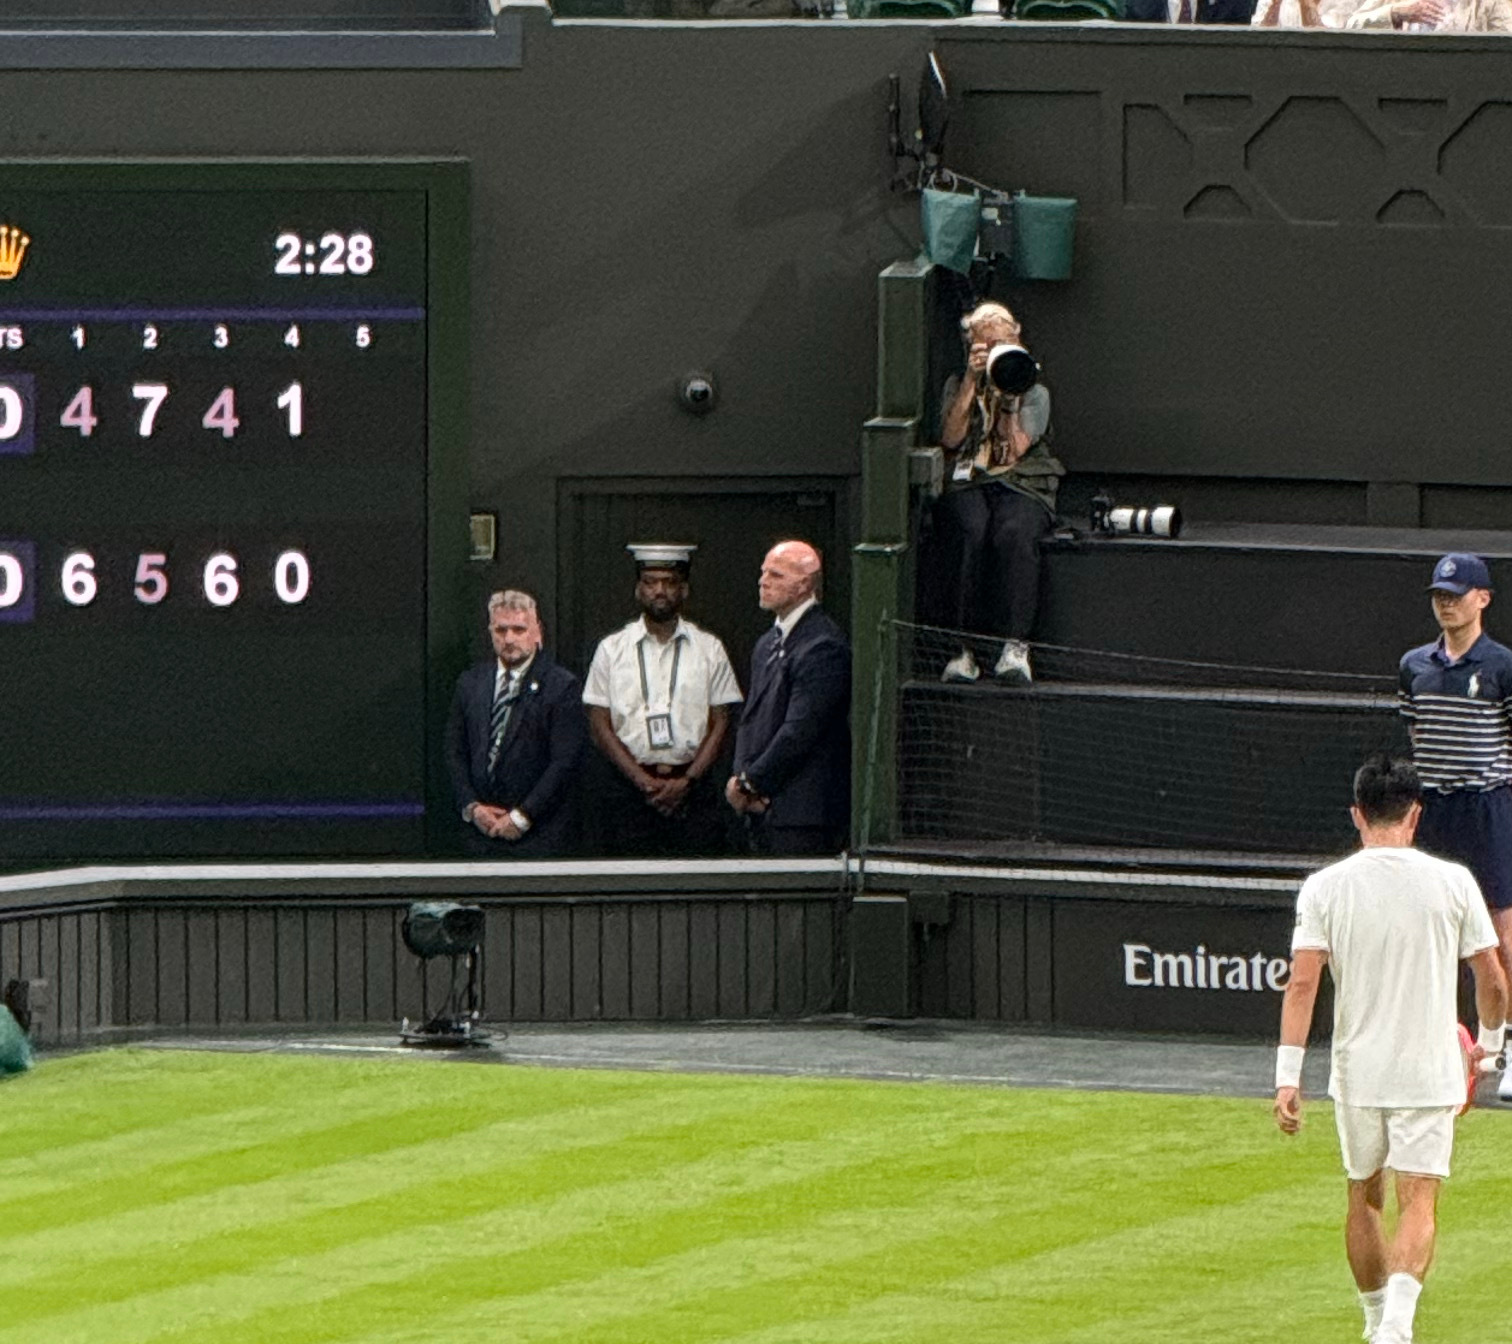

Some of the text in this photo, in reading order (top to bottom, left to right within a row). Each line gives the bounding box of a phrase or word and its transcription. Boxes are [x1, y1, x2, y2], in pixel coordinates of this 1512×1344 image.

[274, 232, 374, 276] 2:28
[70, 324, 85, 350] 1
[142, 324, 158, 350] 2
[213, 324, 229, 350] 3
[283, 324, 300, 349] 4
[355, 324, 371, 349] 5
[60, 386, 97, 437] 4
[132, 383, 168, 438] 7
[202, 387, 240, 438] 4
[276, 381, 303, 437] 1
[60, 551, 97, 606] 6
[134, 553, 168, 604] 5
[202, 552, 240, 607] 6
[274, 549, 310, 604] 0
[1123, 943, 1292, 991] Emirate
